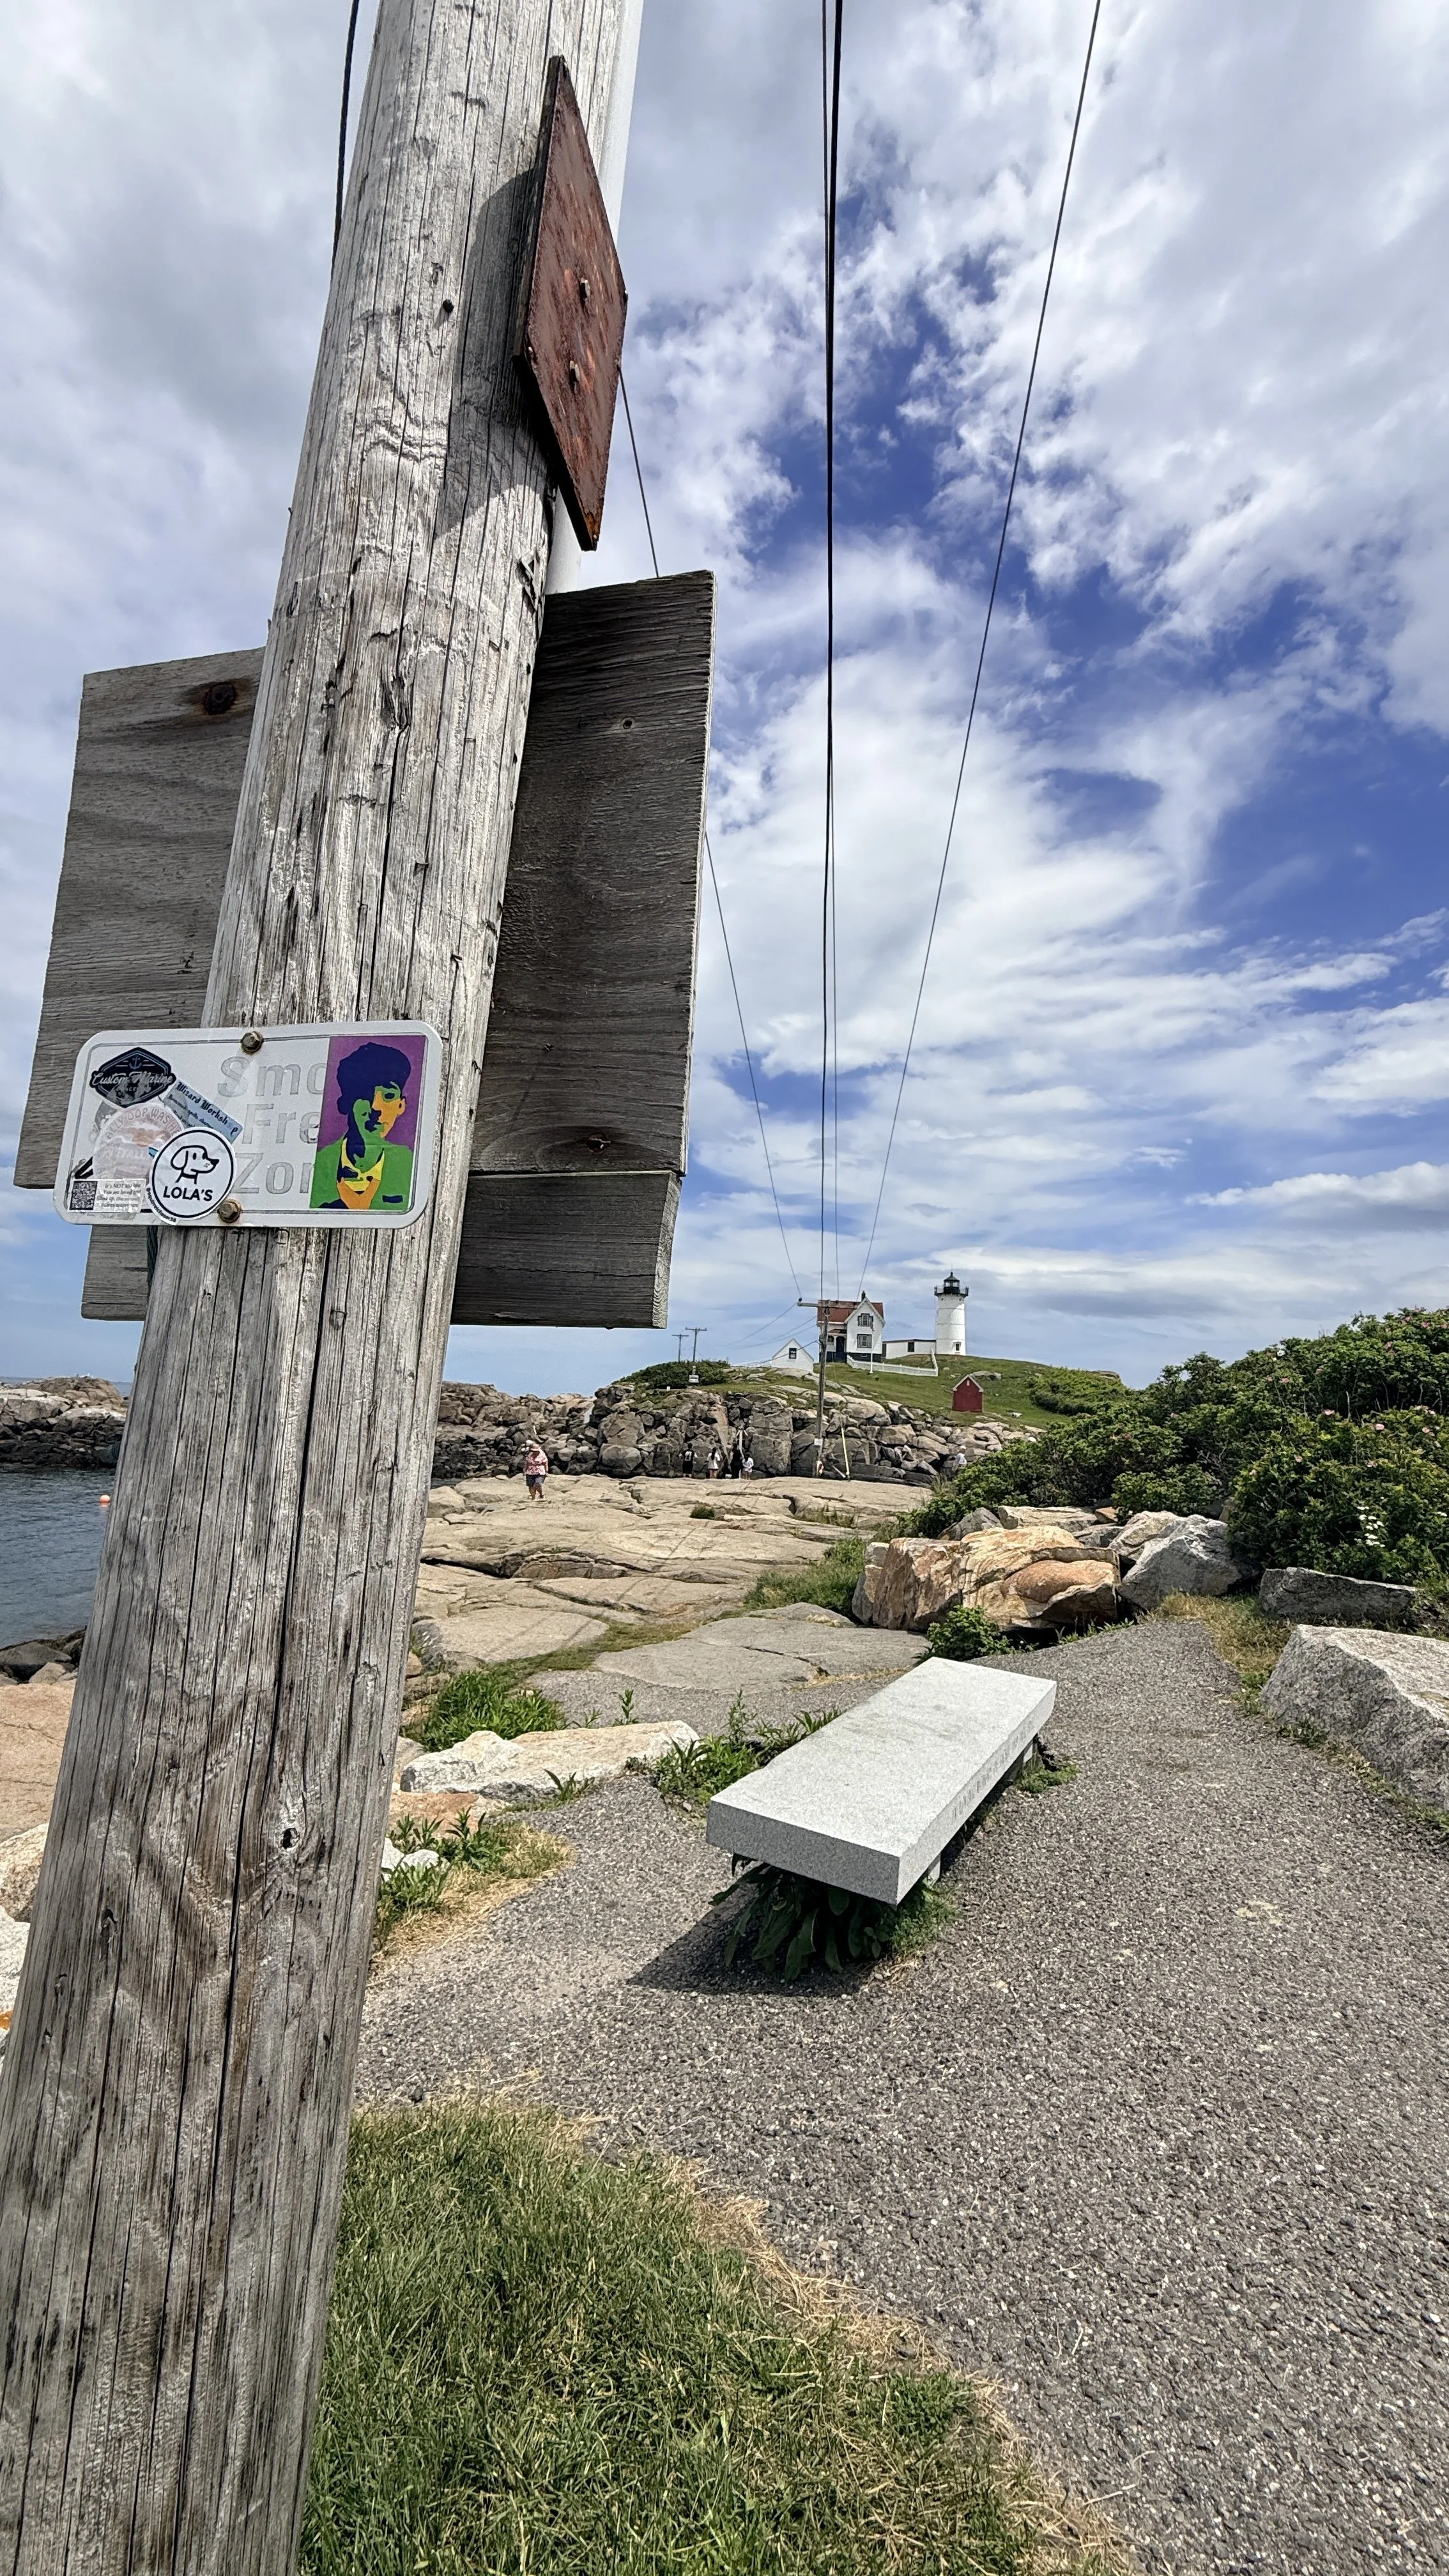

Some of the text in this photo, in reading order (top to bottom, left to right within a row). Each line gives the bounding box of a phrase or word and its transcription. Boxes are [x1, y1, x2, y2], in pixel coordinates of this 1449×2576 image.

[92, 1071, 173, 1085] Custom Marine
[176, 1082, 201, 1103] Wizard
[128, 1108, 148, 1121] OOP
[151, 1107, 170, 1124] WAS
[163, 1186, 213, 1202] LOLA'S
